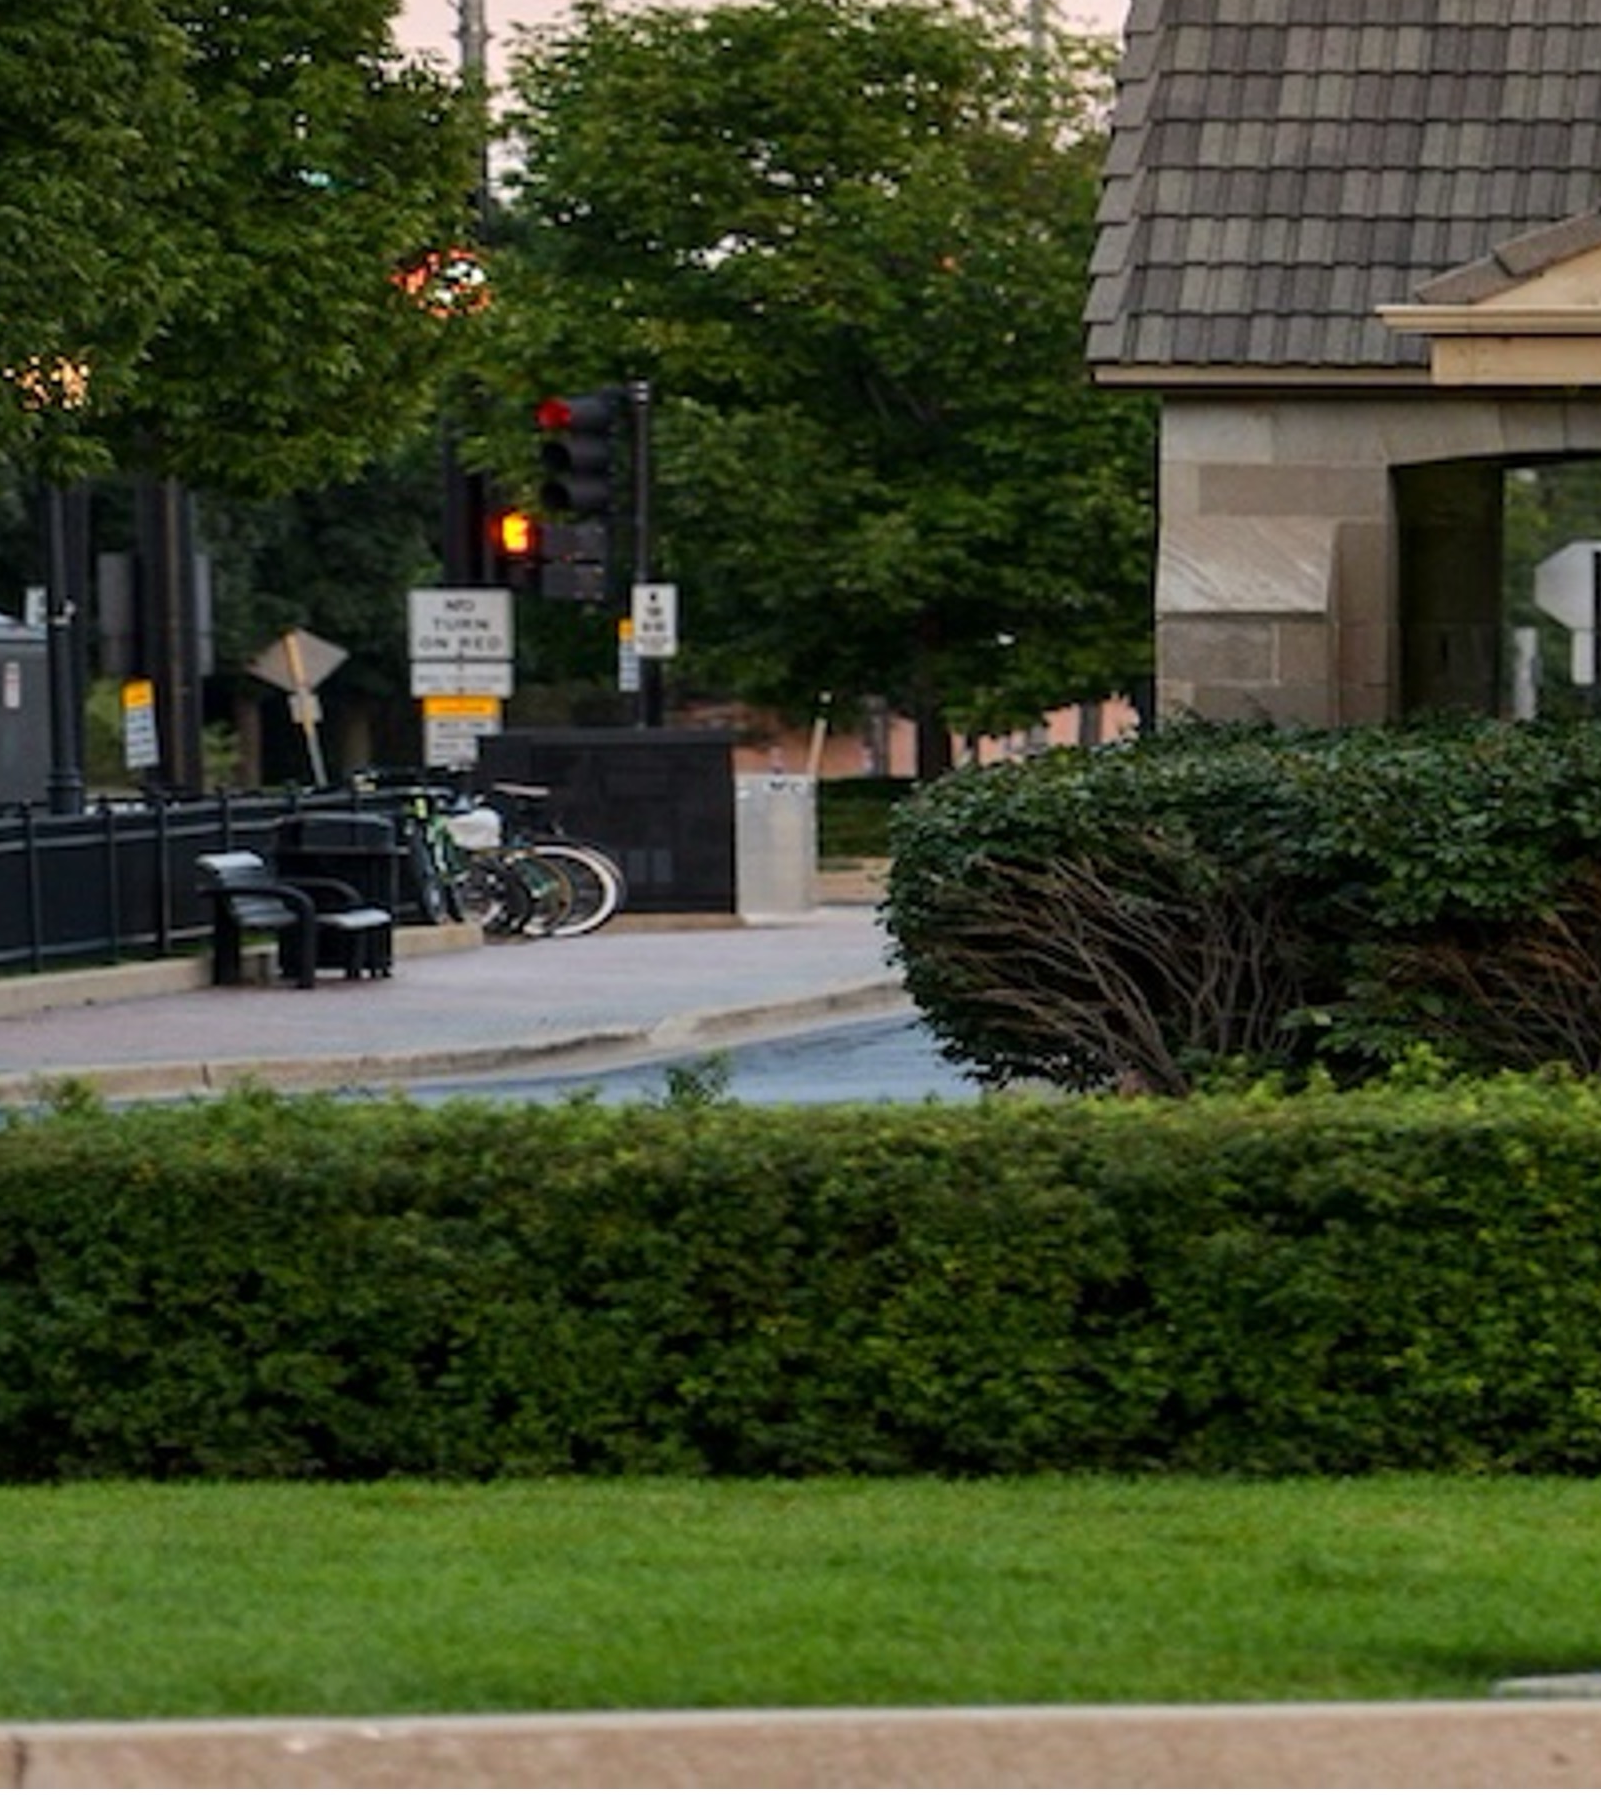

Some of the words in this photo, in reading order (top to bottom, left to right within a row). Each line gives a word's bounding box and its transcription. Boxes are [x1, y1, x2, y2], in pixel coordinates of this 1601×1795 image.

[432, 618, 490, 632] TURN
[418, 635, 449, 650] ON
[458, 635, 503, 650] RED
